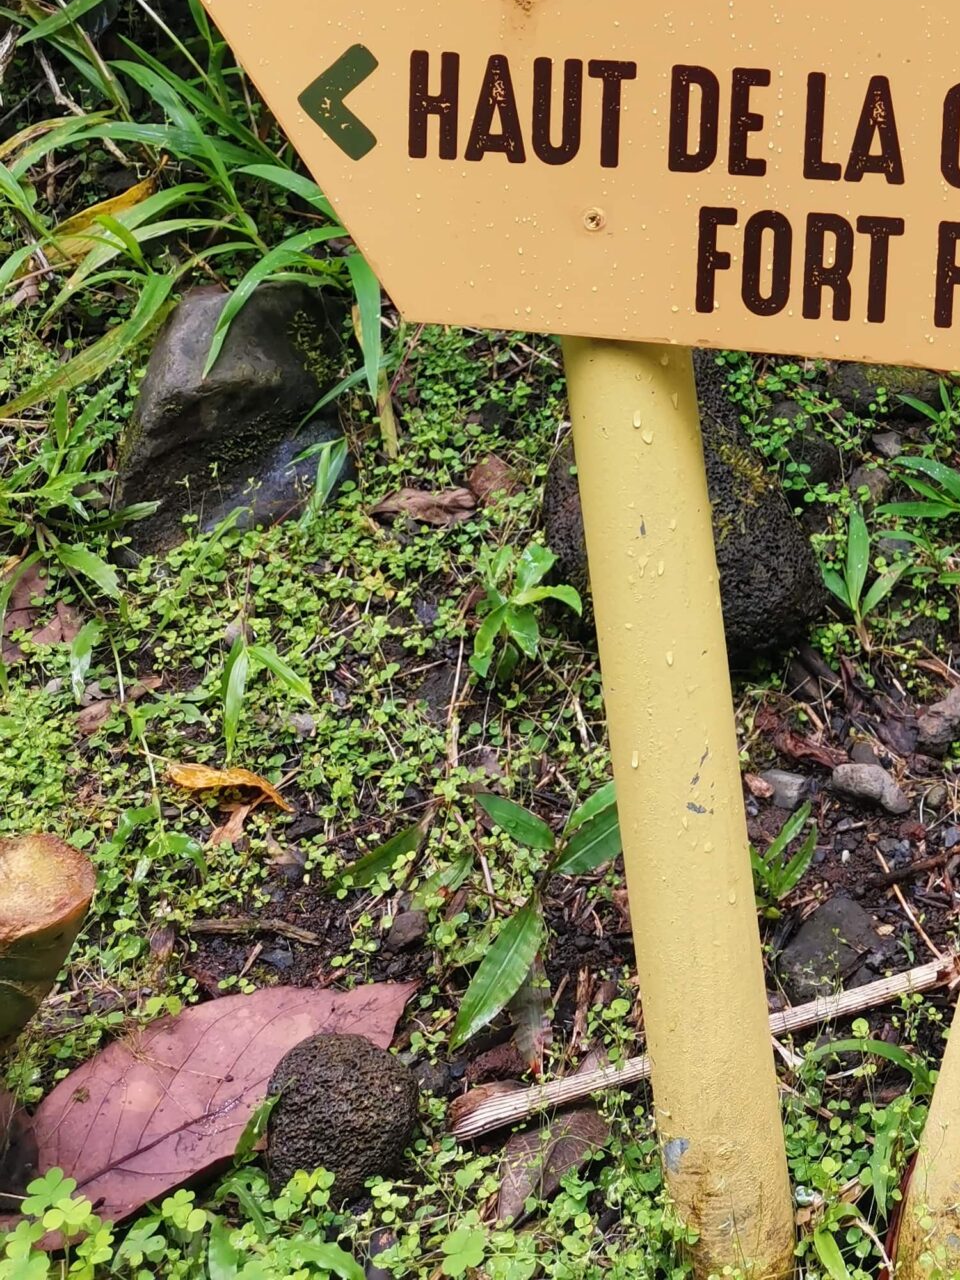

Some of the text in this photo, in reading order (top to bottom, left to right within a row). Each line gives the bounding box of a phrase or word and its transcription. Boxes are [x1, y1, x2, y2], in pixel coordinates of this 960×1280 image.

[408, 49, 638, 168] HAUT
[668, 64, 772, 177] DE
[803, 71, 905, 185] LA
[695, 206, 905, 324] FORT
